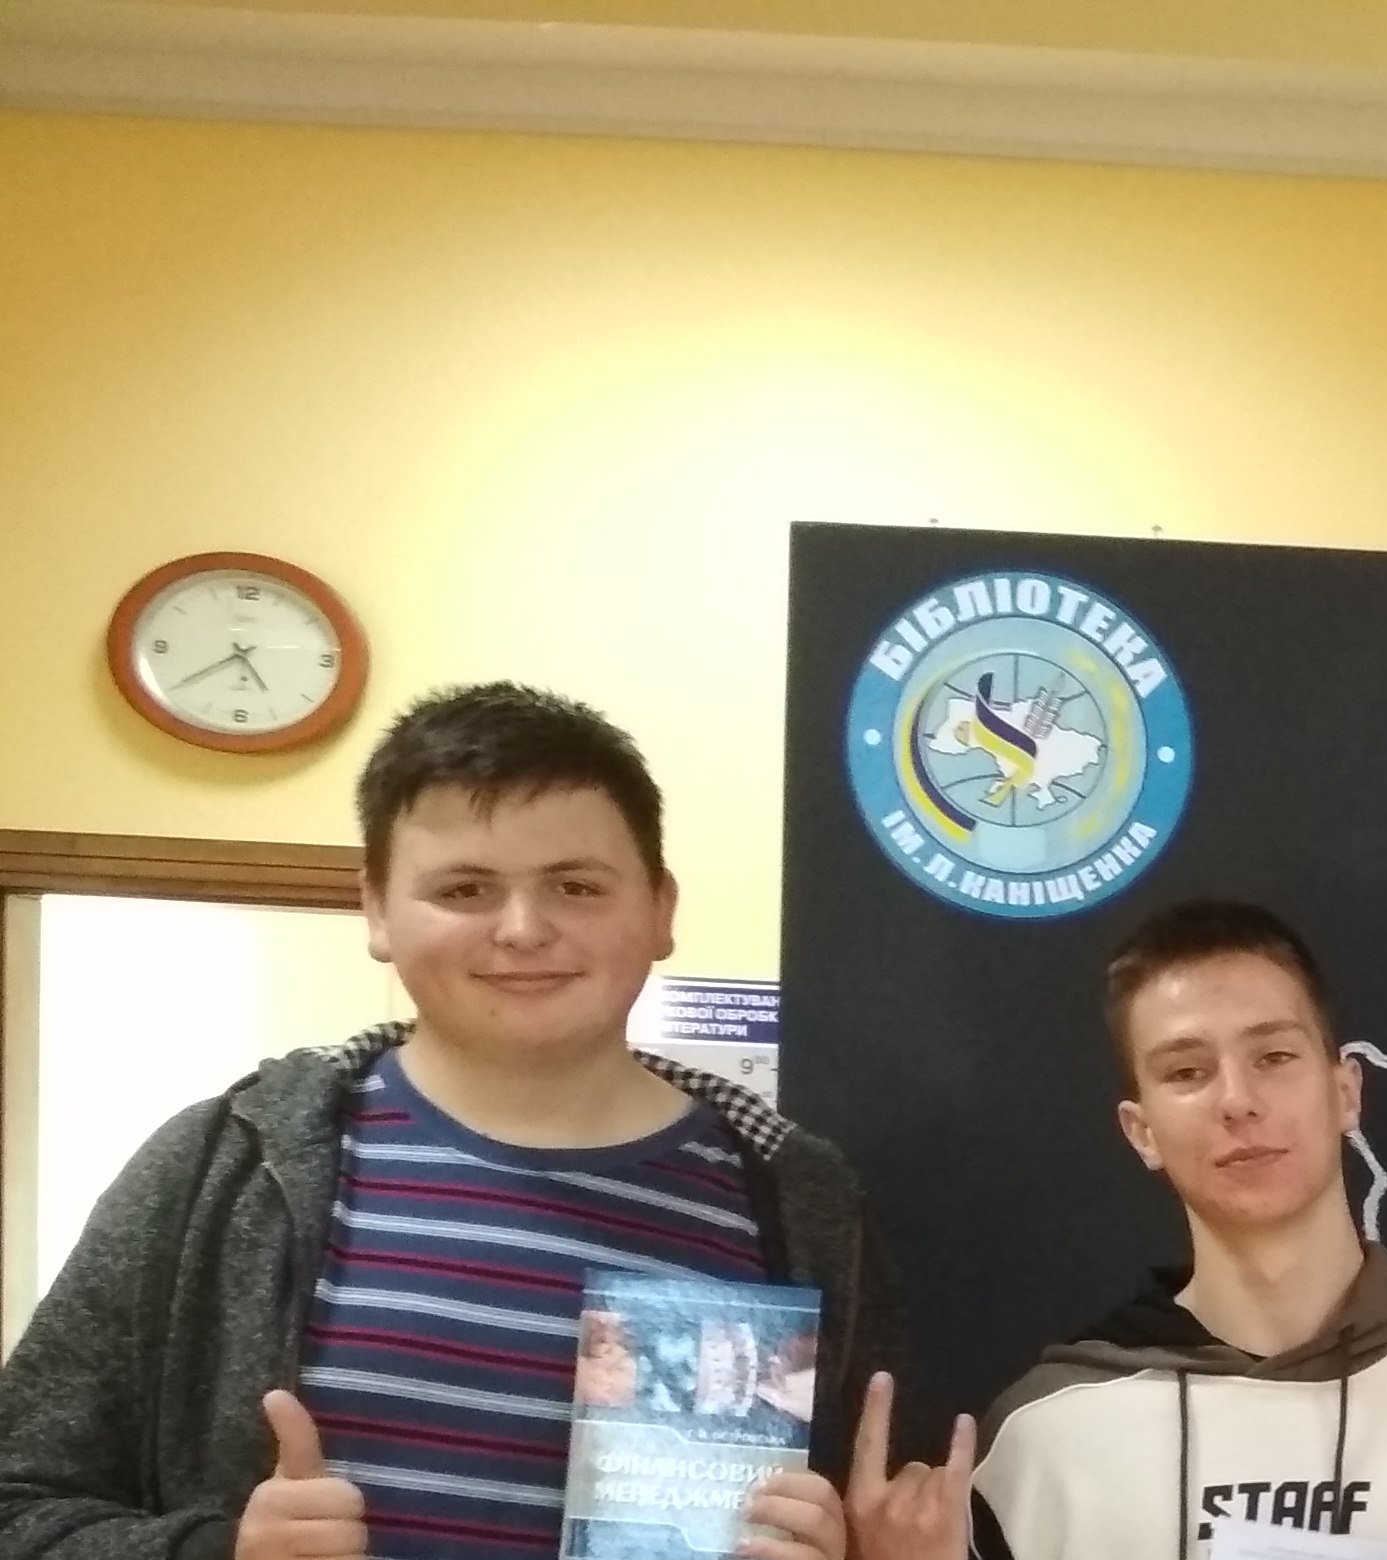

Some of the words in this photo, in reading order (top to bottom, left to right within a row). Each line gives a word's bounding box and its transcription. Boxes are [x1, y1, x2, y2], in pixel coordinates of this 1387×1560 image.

[235, 585, 260, 601] 12
[869, 577, 1168, 699] БІБЛІОТЕКА
[152, 639, 169, 654] 9
[319, 653, 335, 669] 3
[233, 709, 249, 723] 6
[594, 1480, 746, 1511] МЕНЕДЖМЕ
